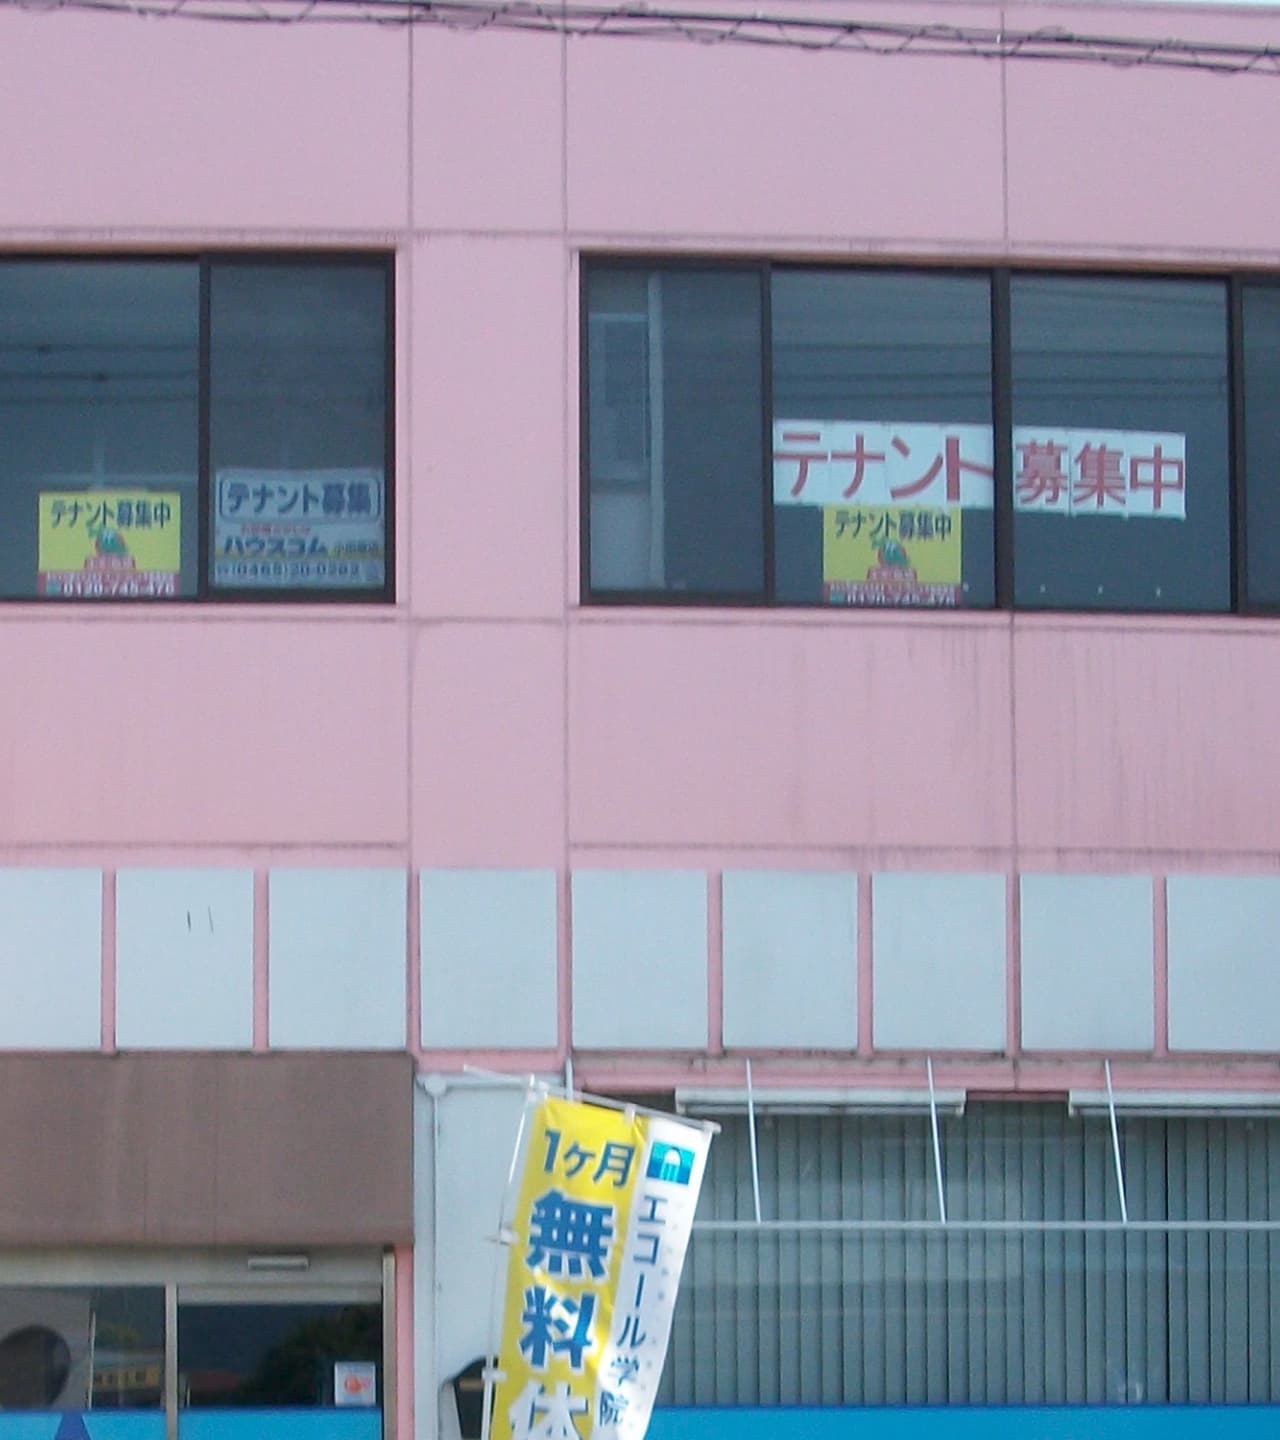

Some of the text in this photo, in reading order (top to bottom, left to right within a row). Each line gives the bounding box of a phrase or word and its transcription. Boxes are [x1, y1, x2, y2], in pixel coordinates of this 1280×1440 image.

[774, 433, 1185, 511] テナント 募集中
[51, 499, 171, 529] テナント募集中
[228, 482, 371, 514] テナント募集
[835, 509, 952, 541] テナント募集中
[542, 1127, 636, 1189] 1ヶ月
[597, 1194, 666, 1428] エコール学院
